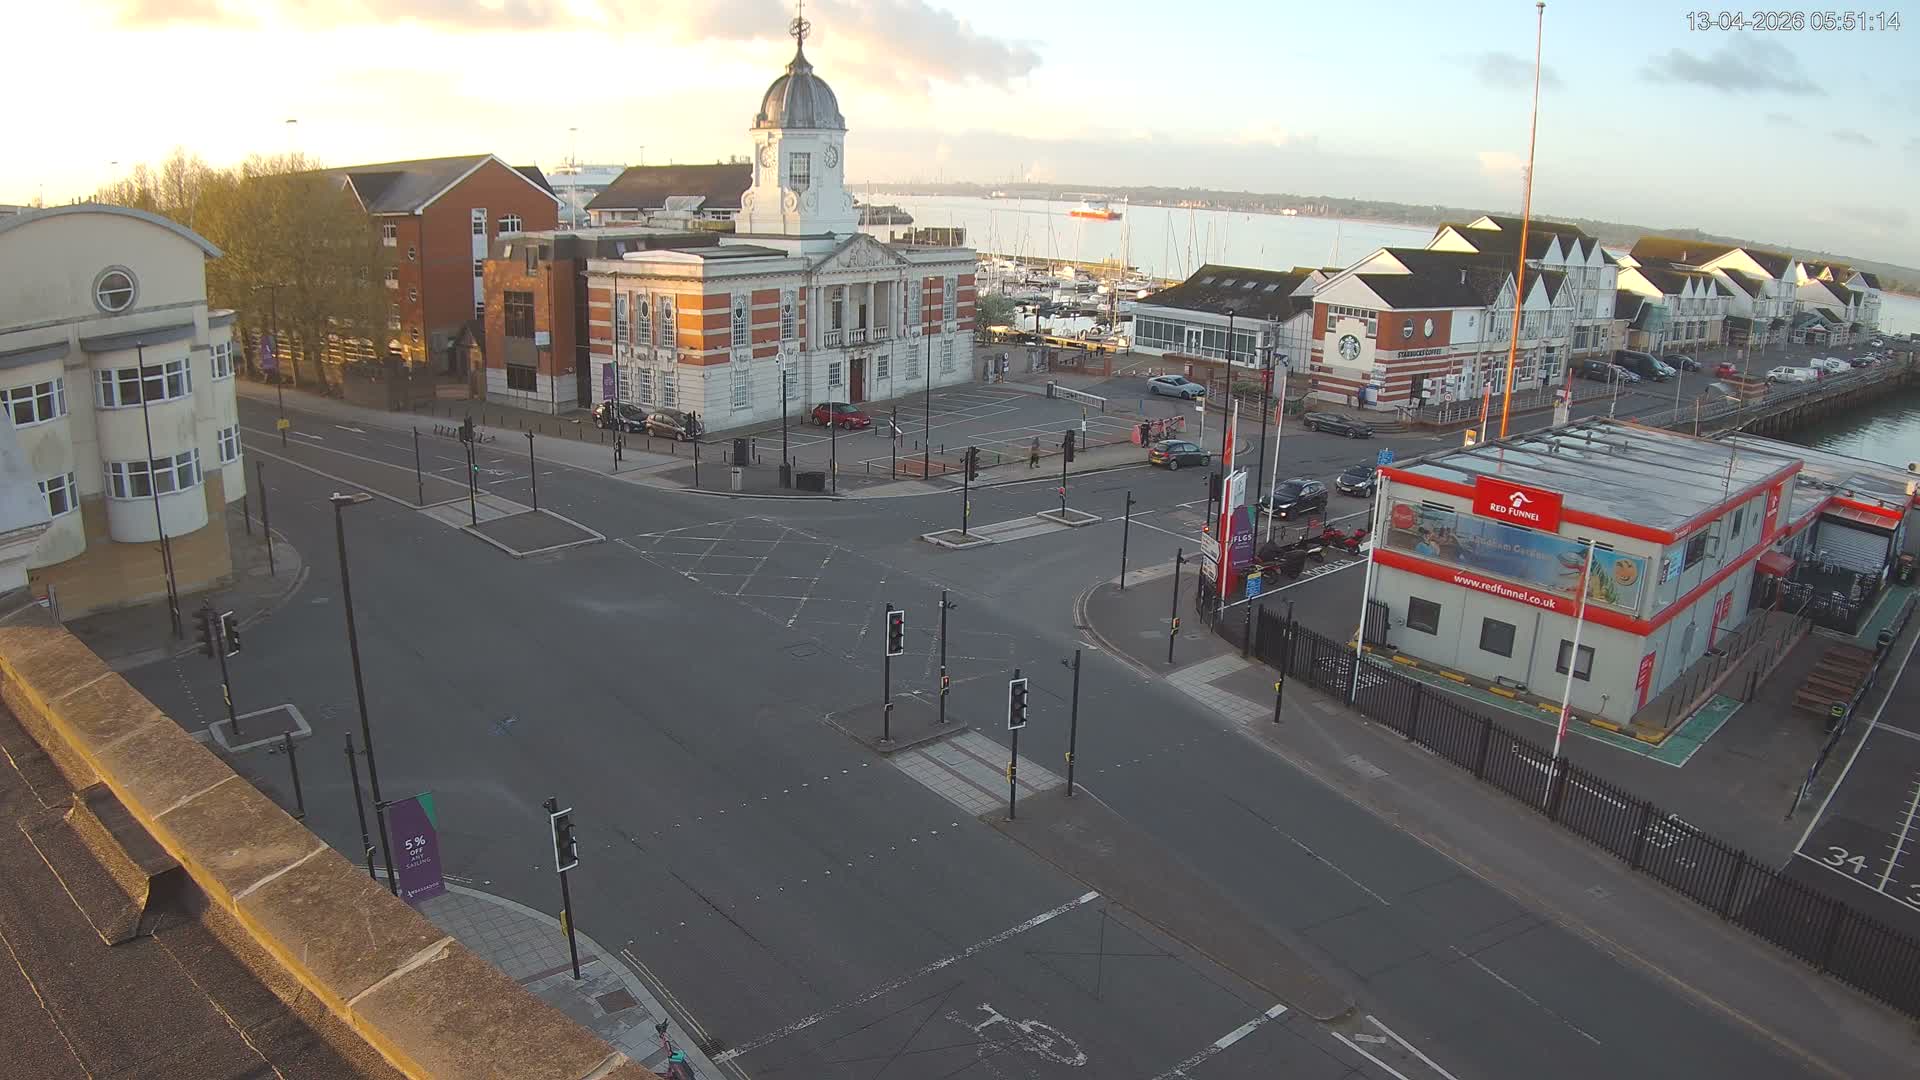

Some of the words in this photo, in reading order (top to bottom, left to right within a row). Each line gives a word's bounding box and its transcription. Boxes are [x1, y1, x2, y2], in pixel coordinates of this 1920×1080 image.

[1490, 503, 1507, 513] RED
[1508, 507, 1540, 521] FUNNEL
[1454, 575, 1556, 609] www.redfunnel.co.uk
[410, 847, 423, 856] OFF
[411, 854, 424, 862] ANY
[406, 857, 431, 869] SAILING
[1822, 846, 1868, 874] 34
